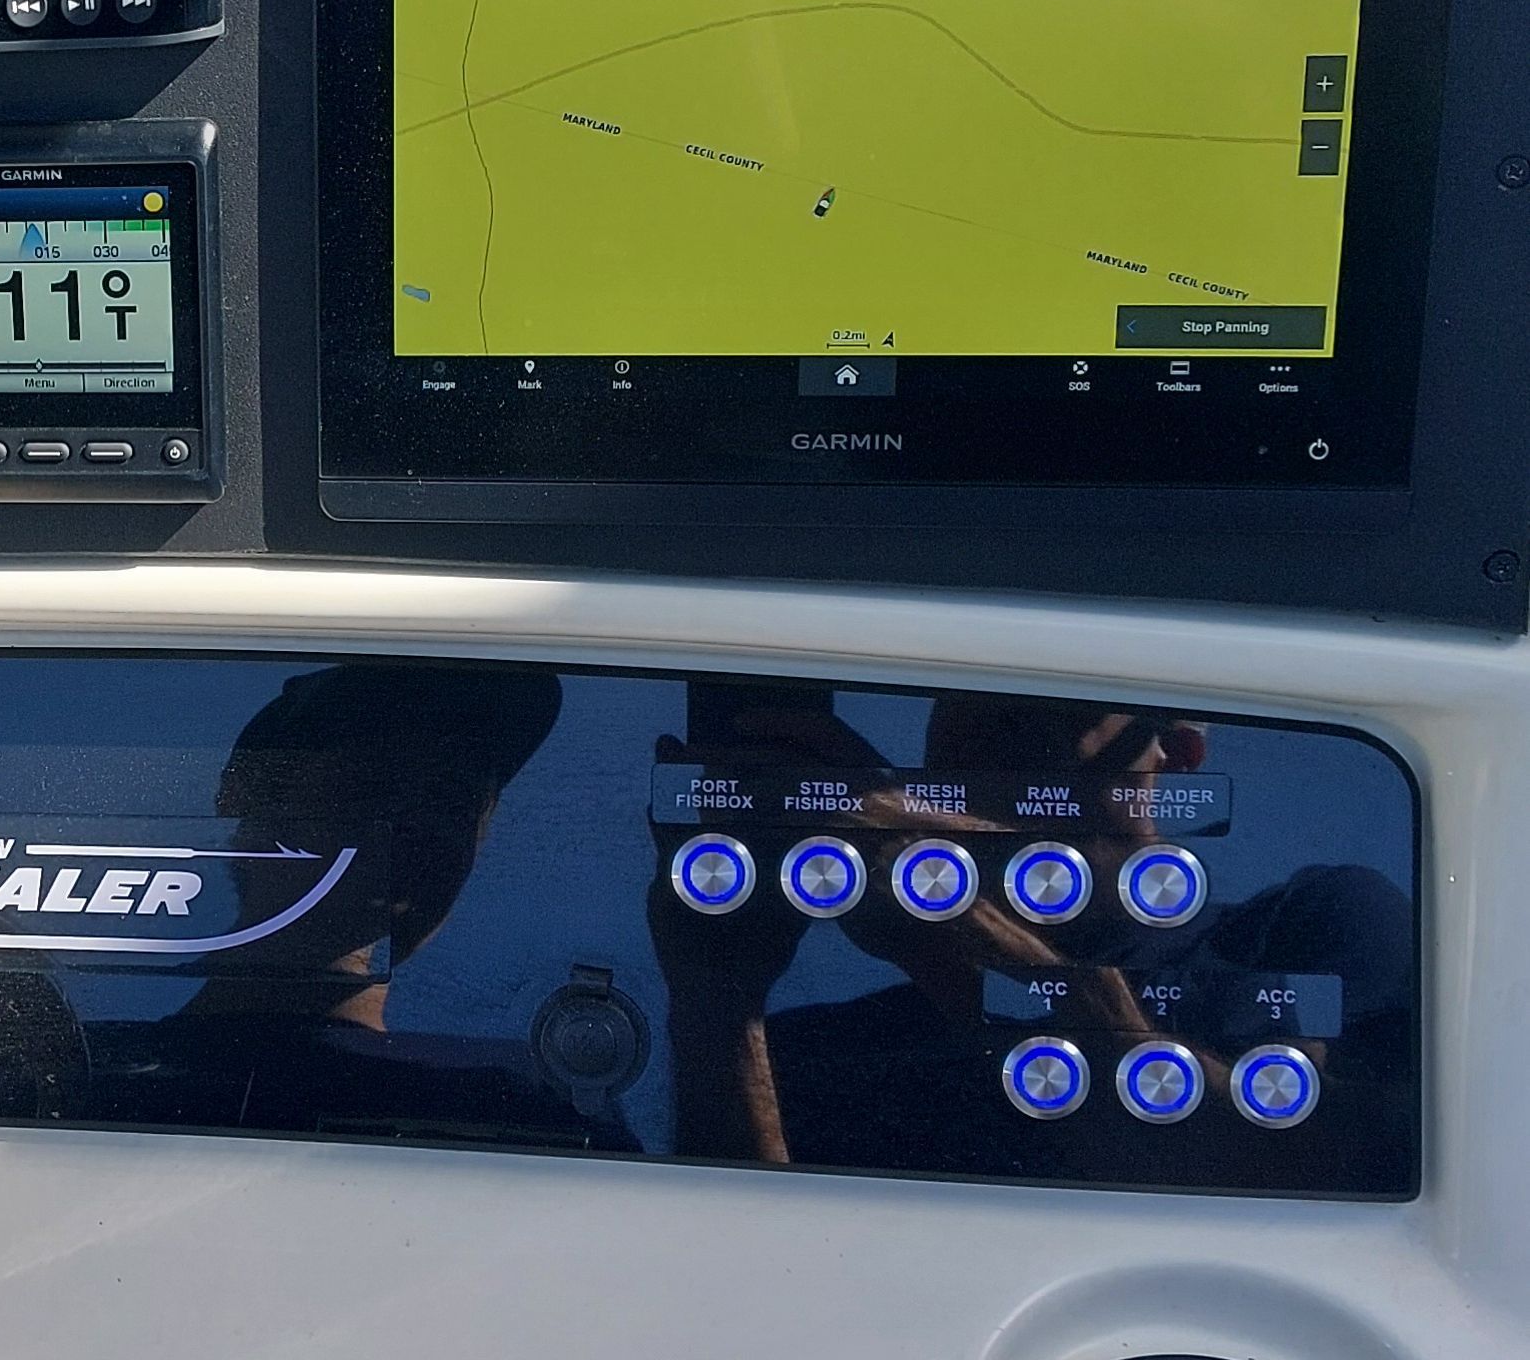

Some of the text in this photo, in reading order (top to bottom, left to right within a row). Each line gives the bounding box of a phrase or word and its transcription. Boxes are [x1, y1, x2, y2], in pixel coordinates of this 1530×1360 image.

[562, 111, 766, 172] MARYLAND CECIL COUNTY
[1, 169, 63, 181] GARMIN
[34, 246, 61, 259] 015
[93, 246, 119, 259] 030
[1085, 250, 1250, 303] MARYLAND CECIL COUNTY
[104, 305, 138, 341] T
[1181, 320, 1269, 336] Stop Panning
[24, 377, 56, 389] Menu
[103, 377, 156, 389] Direction
[422, 379, 1299, 395] Engage Mark Info SOS Toolbars Options
[790, 433, 903, 451] GARMIN
[690, 779, 739, 794] PORT
[799, 781, 848, 796] STBD
[904, 783, 966, 798] FRESH
[1027, 786, 1071, 801] RAW
[675, 794, 754, 809] FISHBOX
[1111, 787, 1214, 803] SPREADER
[784, 796, 864, 812] FISHBOX
[902, 798, 967, 814] WATER
[1015, 801, 1080, 817] WATER
[1128, 803, 1196, 819] LIGHTS
[1028, 980, 1068, 996] ACC
[1141, 984, 1182, 1000] ACC
[1043, 996, 1052, 1011] 1
[1255, 989, 1297, 1004] ACC
[1156, 1000, 1167, 1016] 2
[1270, 1004, 1281, 1020] 3
